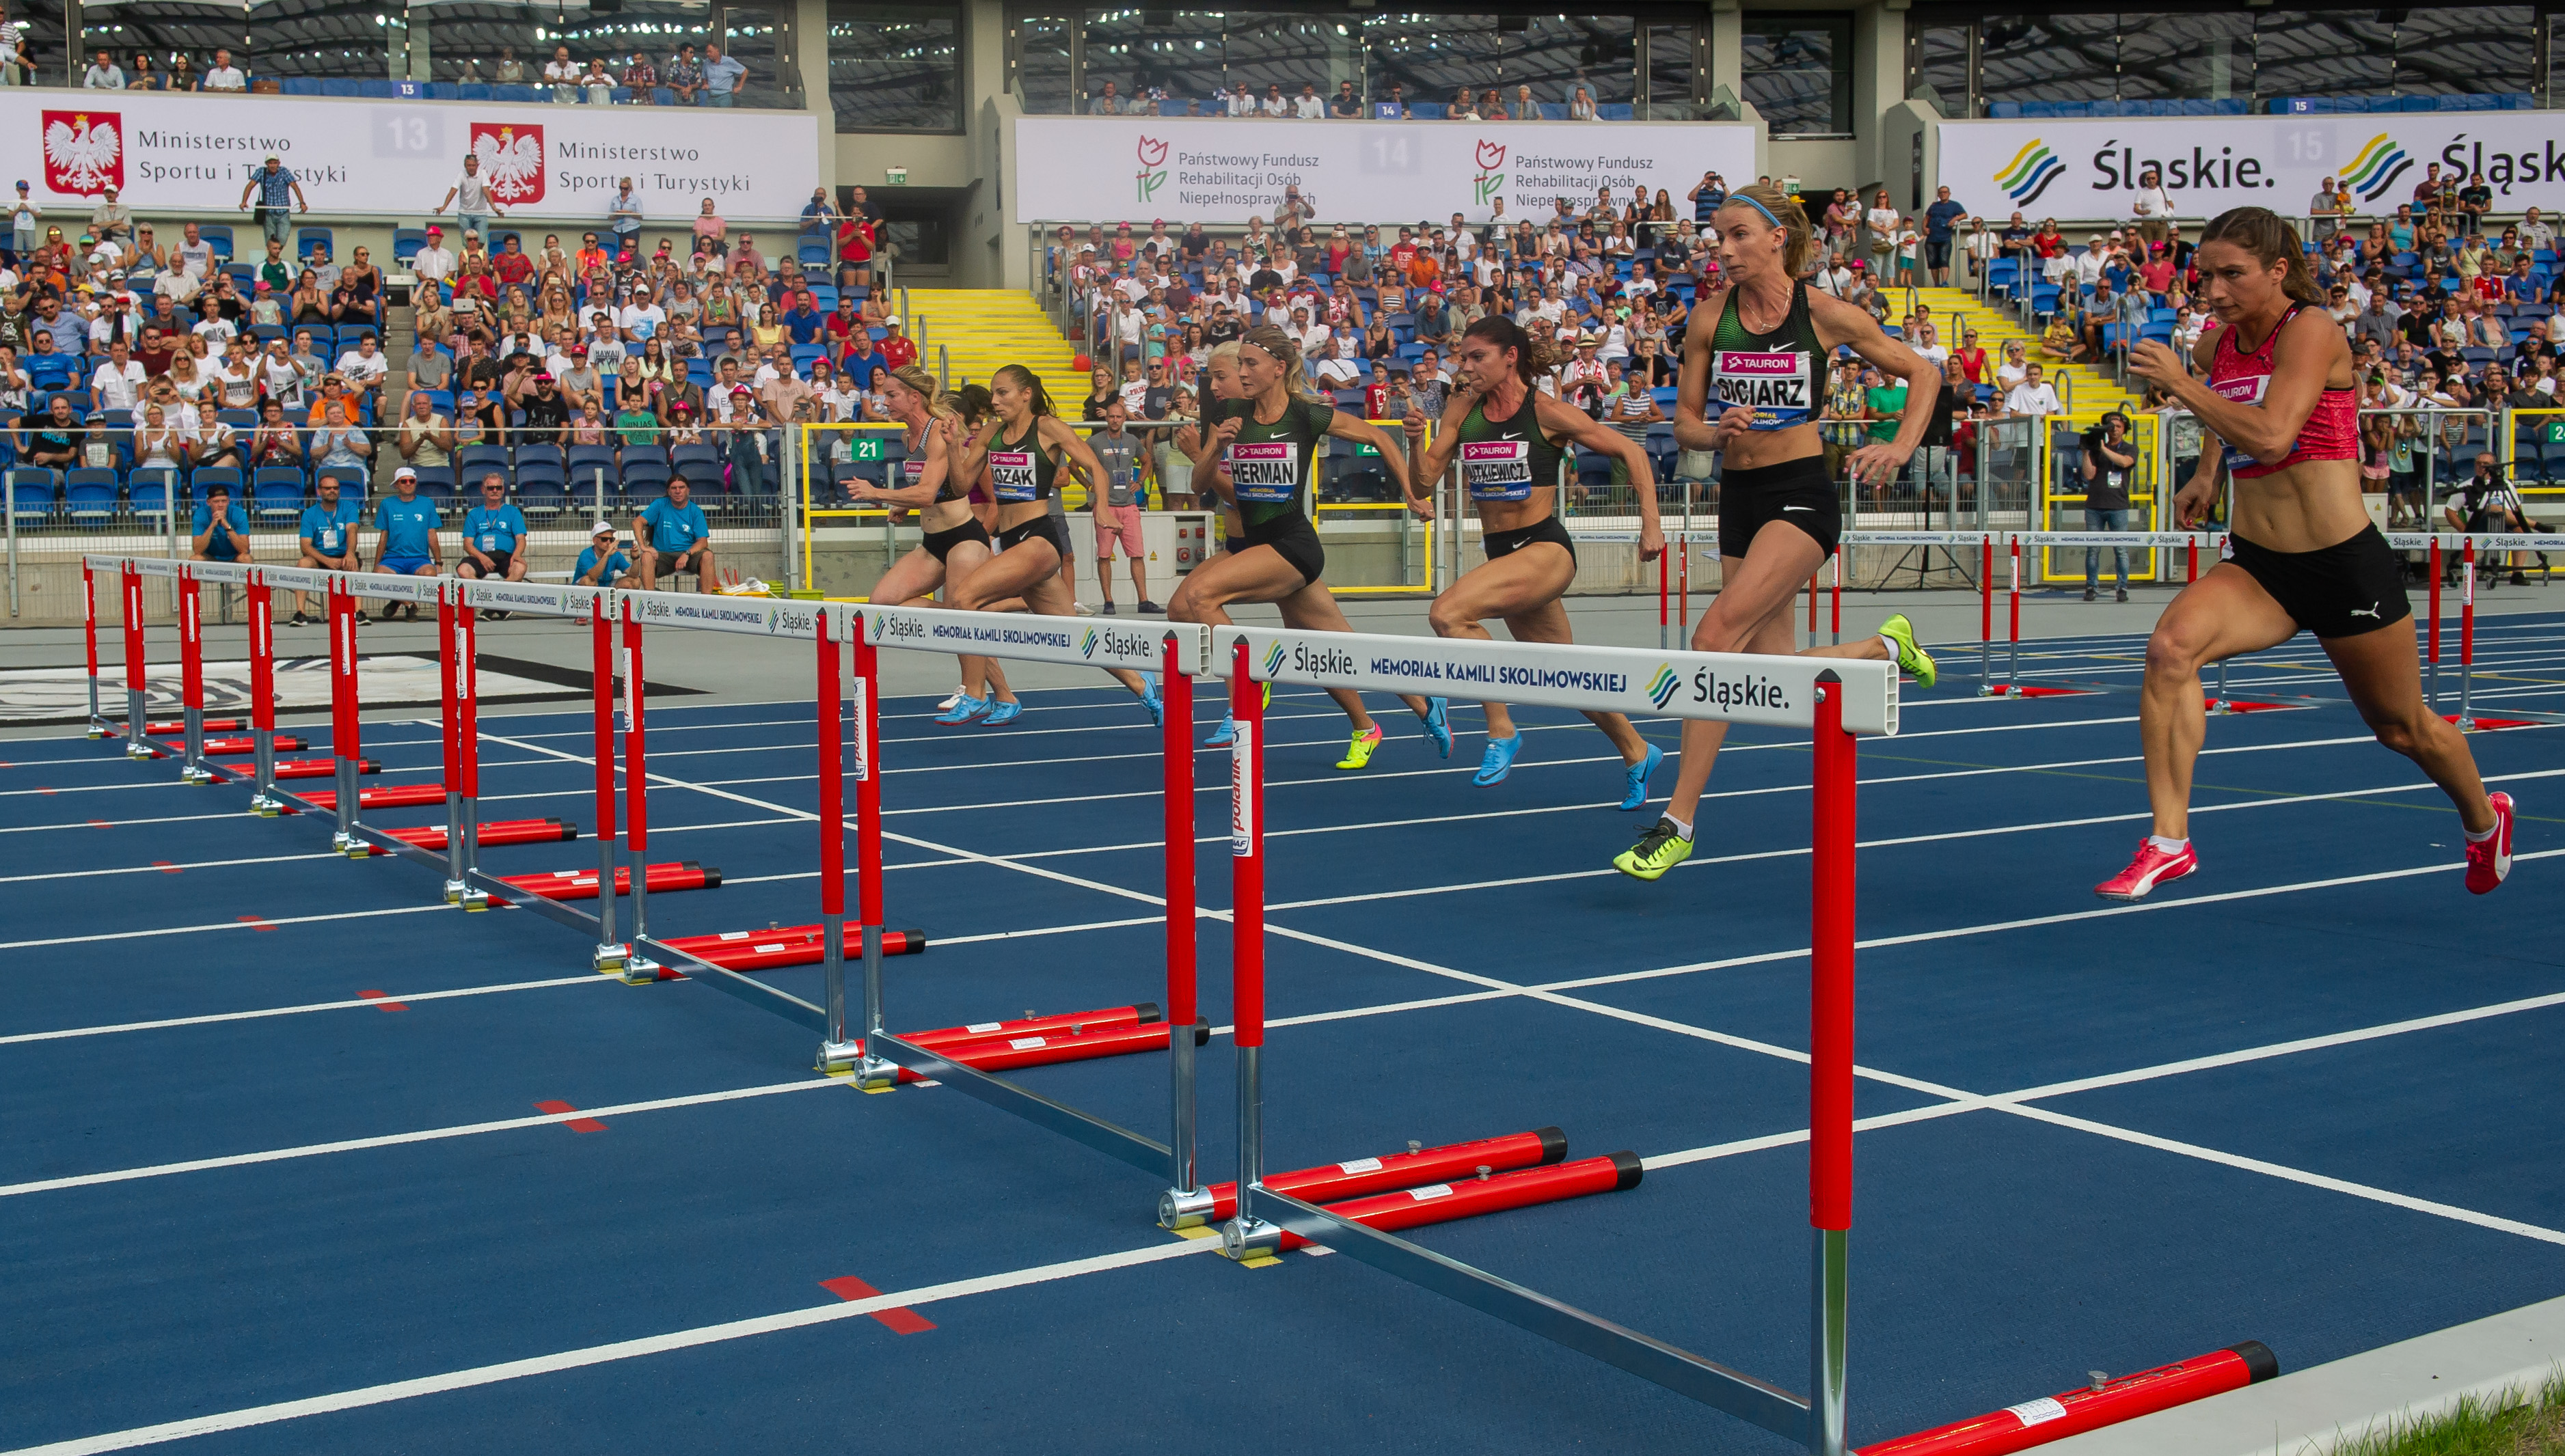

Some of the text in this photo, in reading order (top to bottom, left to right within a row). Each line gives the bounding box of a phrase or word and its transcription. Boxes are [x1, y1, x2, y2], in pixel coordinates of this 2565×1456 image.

[401, 84, 414, 94] 13
[1382, 106, 1394, 115] 14
[2295, 102, 2306, 111] 15
[139, 130, 291, 151] Ministerstwo
[388, 116, 429, 150] 13
[559, 141, 699, 161] Ministerstwo
[1372, 137, 1410, 167] 14
[2288, 131, 2324, 161] 15
[1178, 152, 1319, 170] Państwowy Fundusz
[1516, 154, 1653, 172] Państwowy Fundusz
[140, 161, 347, 187] Sportu i Tstyki
[1179, 171, 1302, 189] Rehabilitacji Osób
[1516, 174, 1636, 191] Rehabilitacji Osób
[640, 173, 644, 189] i
[653, 173, 750, 195] Turystyki
[1743, 359, 1789, 368] TAURON
[2218, 384, 2253, 399] TAURON
[2555, 426, 2565, 440] 2
[859, 441, 876, 457] 21
[1479, 446, 1512, 455] TAURON
[1230, 462, 1293, 484] HERMAN
[2393, 536, 2424, 548] Śląskie.
[2496, 536, 2528, 549] Śląskie.
[647, 597, 671, 620] Śląskie.
[675, 606, 701, 618] MEMORIAŁ
[701, 609, 718, 620] KAMILI
[782, 607, 813, 634] Śląskie.
[890, 612, 1153, 661] Śląskie. MEMORIAŁ KAMILI SKOLIMOWSKIEJ Śląskie.
[1294, 640, 1790, 713] Śląskie. MEMORIAŁ KAMILI SKOLIMOWSKIEJ Śląskie.
